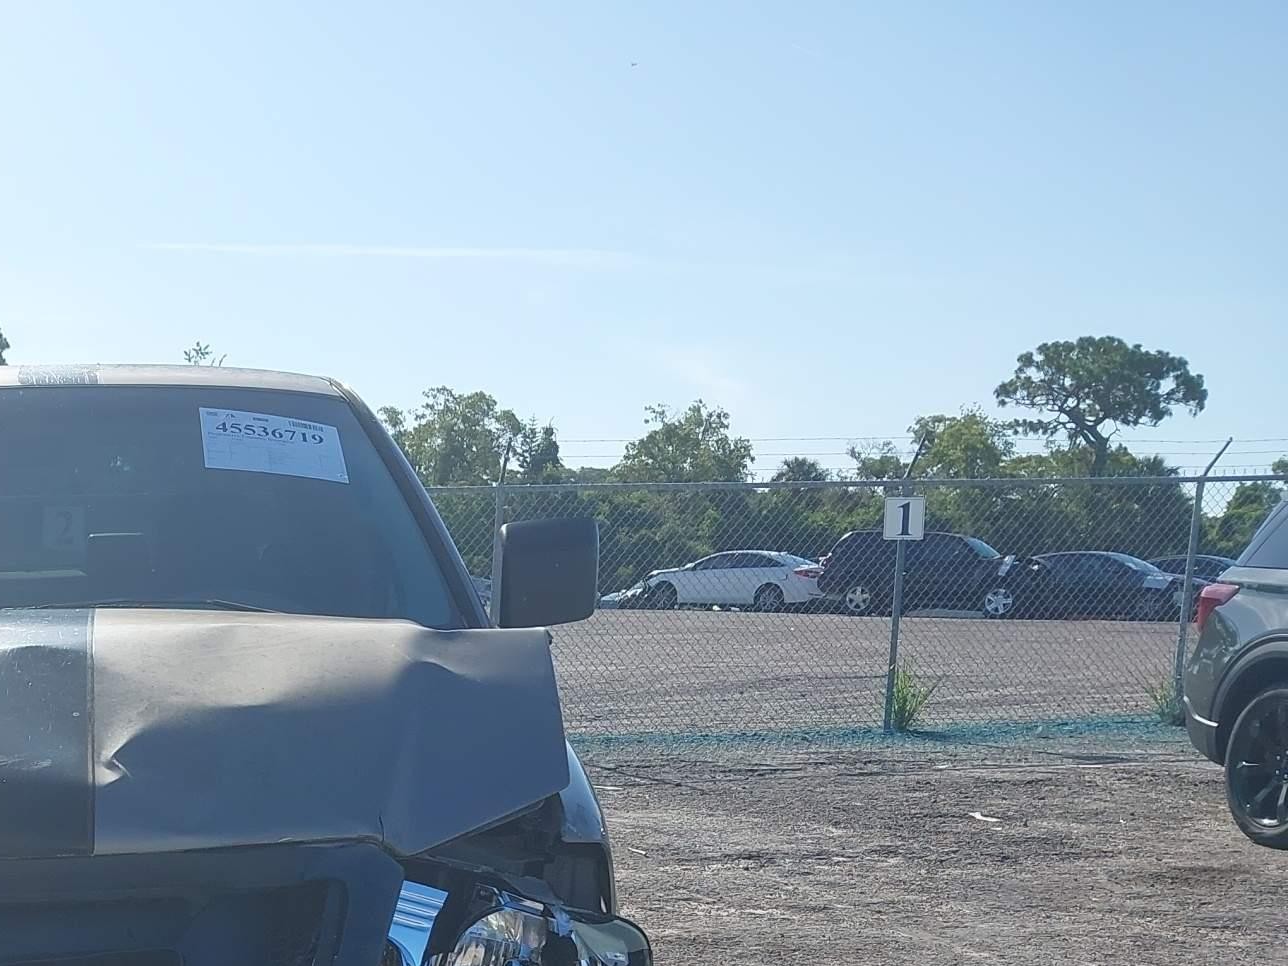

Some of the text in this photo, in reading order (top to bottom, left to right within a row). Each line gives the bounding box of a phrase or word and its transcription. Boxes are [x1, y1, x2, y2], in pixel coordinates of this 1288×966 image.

[215, 421, 325, 445] 45536719
[55, 511, 74, 545] 2
[896, 501, 913, 536] 1
